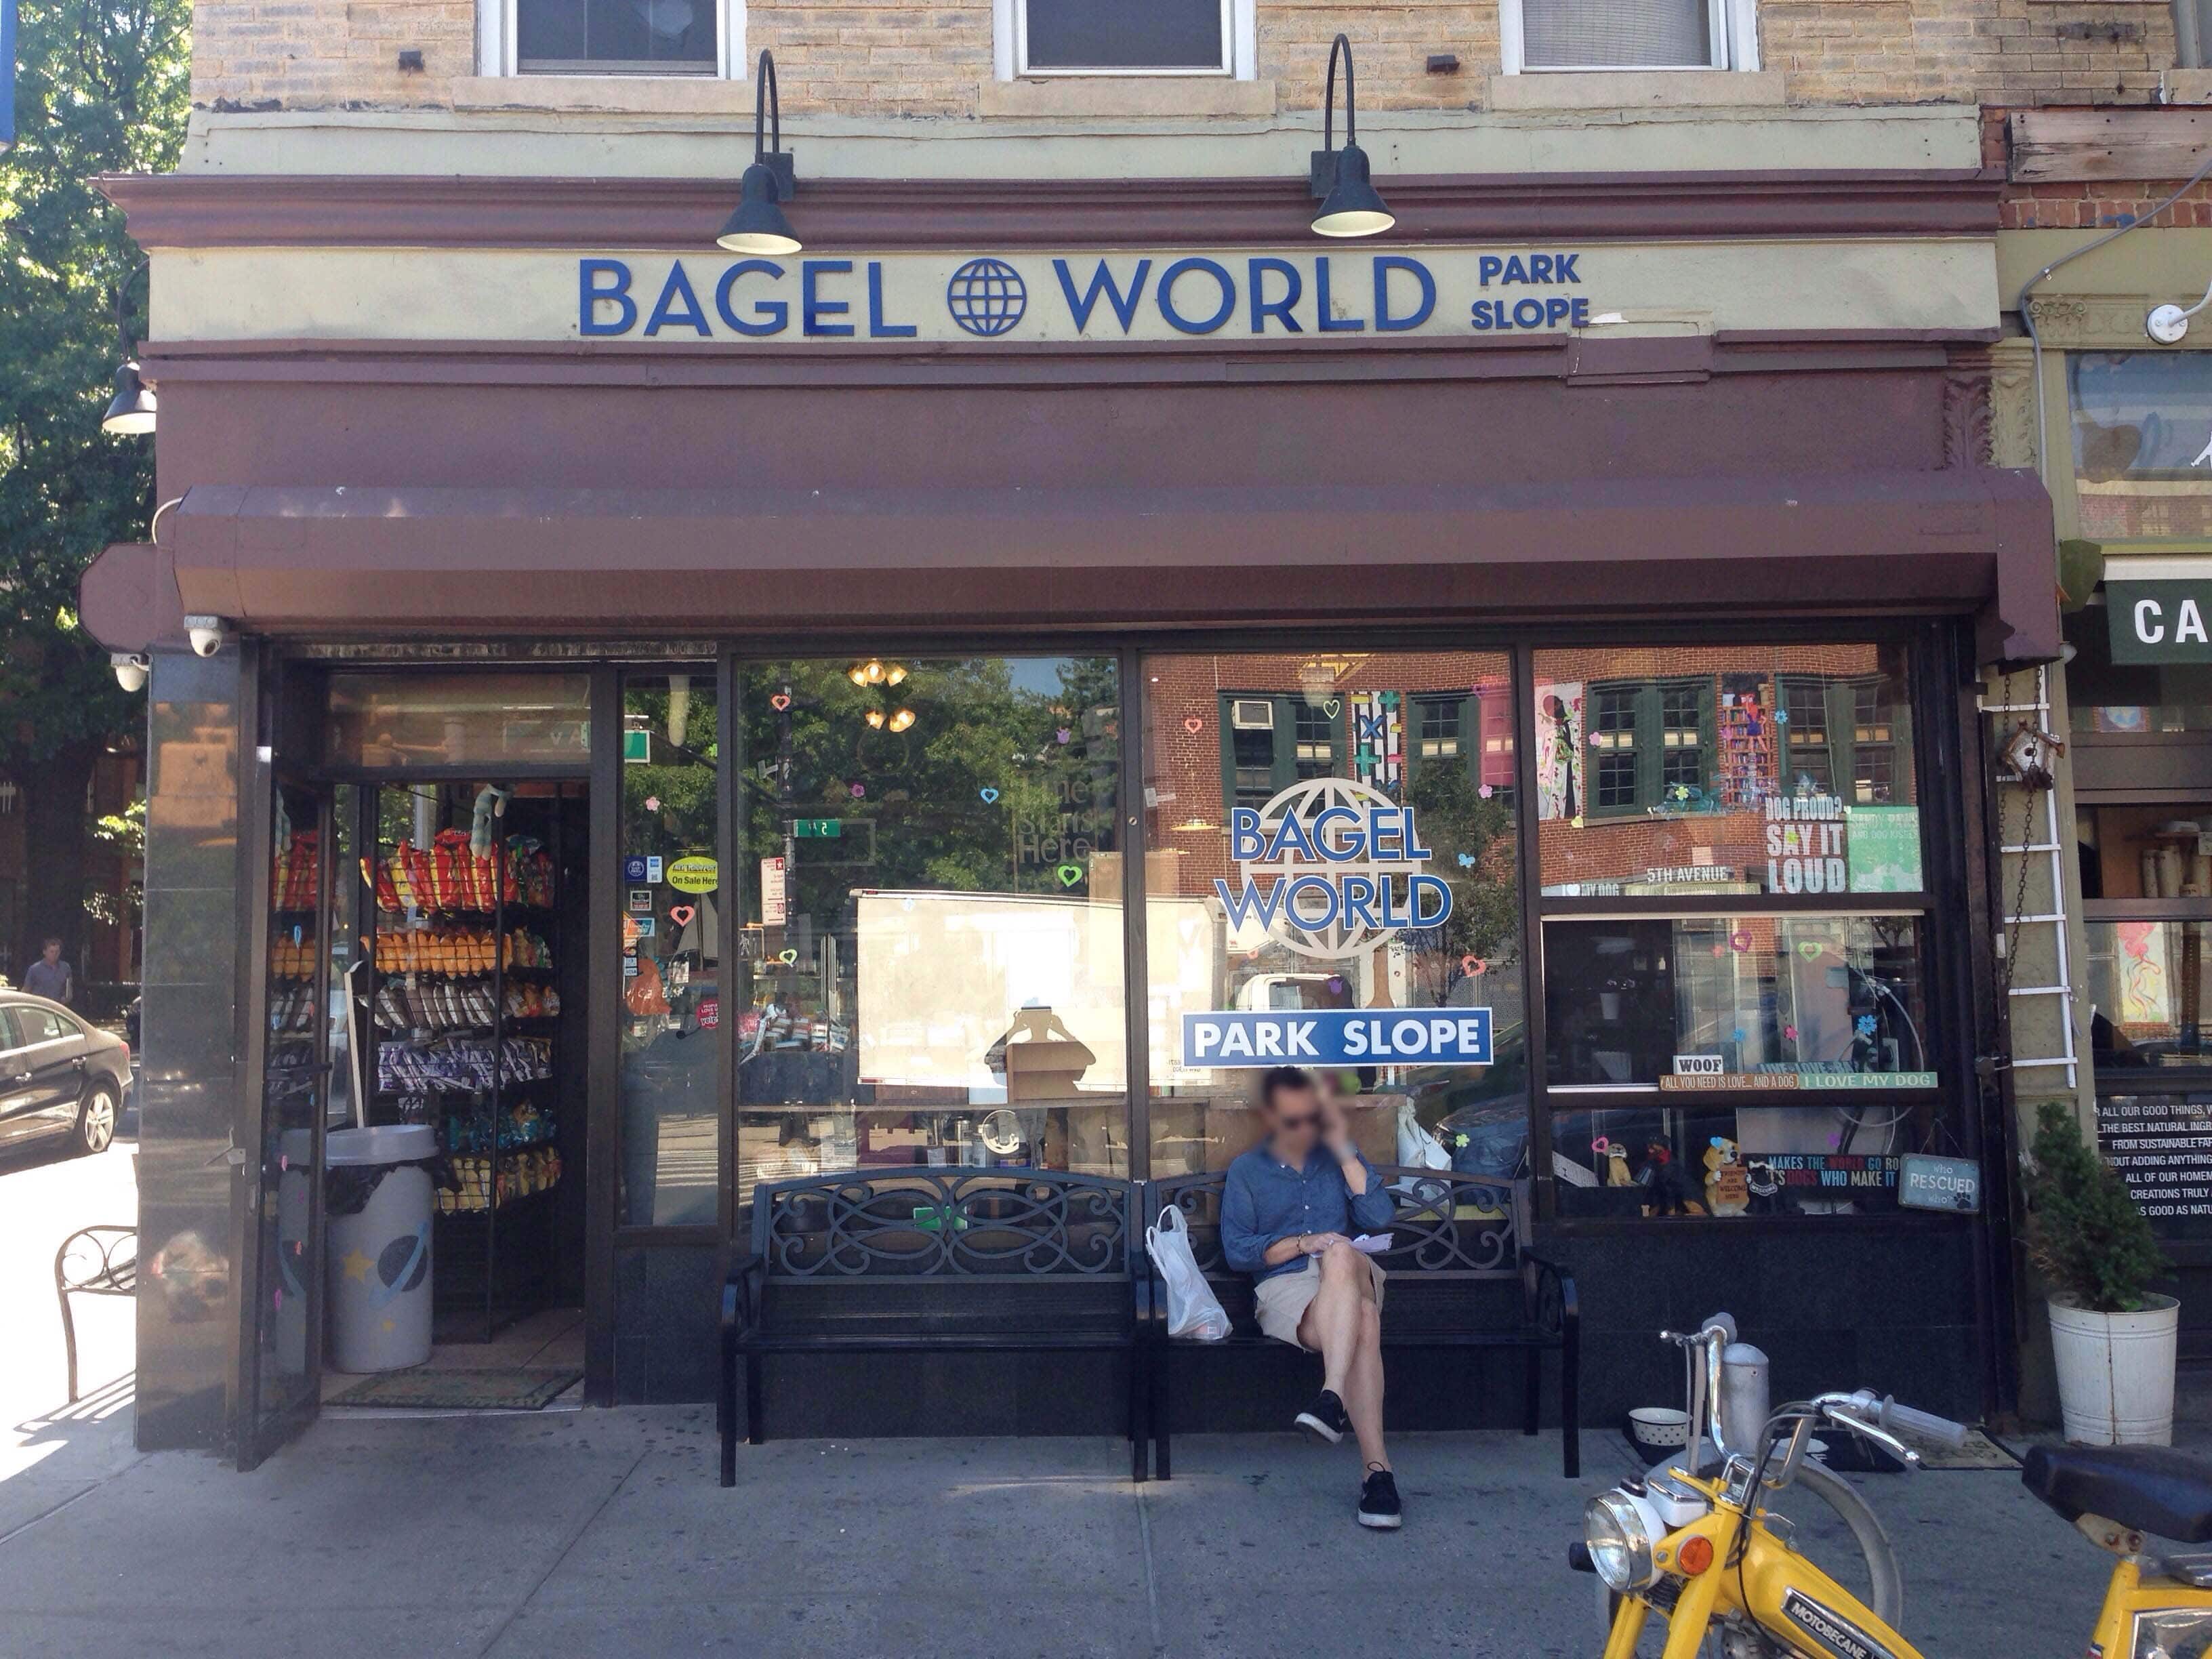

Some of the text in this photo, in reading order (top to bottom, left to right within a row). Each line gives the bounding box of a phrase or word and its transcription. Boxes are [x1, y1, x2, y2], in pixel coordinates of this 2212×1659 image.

[1479, 253, 1582, 287] PARK
[579, 256, 1437, 337] BAGEL WORLD
[1471, 298, 1589, 330] SLOPE
[2135, 599, 2209, 644] CA
[1765, 796, 1790, 821] DOG
[1793, 796, 1843, 821] PROUD?
[1231, 805, 1432, 863] BAGEL
[1766, 823, 1844, 857] SAY IT
[672, 876, 682, 884] On
[684, 876, 701, 884] Sale
[1647, 865, 1729, 882] 5TH AVENUE
[1767, 857, 1847, 894] LOUD
[1214, 874, 1453, 933] WORLD
[1193, 1019, 1480, 1058] PARK SLOPE
[1678, 1059, 1722, 1073] WOOF
[1666, 1075, 1678, 1088] ALL
[1680, 1075, 1696, 1088] YOU
[1697, 1075, 1716, 1088] NEED
[1718, 1075, 1725, 1088] IS
[1754, 1075, 1768, 1088] AND
[1771, 1075, 1777, 1088] A
[1778, 1075, 1794, 1088] DOG
[1805, 1074, 1931, 1088] I LOVE MY DOG
[2103, 1107, 2119, 1117] ALL
[2121, 1106, 2140, 1116] OUR
[2142, 1105, 2168, 1115] GOOD
[2169, 1104, 2205, 1115] THINGS,
[2101, 1123, 2120, 1133] THE
[2122, 1122, 2145, 1132] BEST
[2147, 1122, 2189, 1132] NATURAL
[2112, 1140, 2137, 1150] FROM
[2139, 1138, 2196, 1149] SUSTAINABLE
[1768, 1156, 1803, 1170] MAKES
[1807, 1156, 1825, 1170] THE
[1868, 1157, 1882, 1170] GO
[2131, 1155, 2166, 1166] ADDING
[1820, 1170, 1847, 1187] WHO
[1851, 1170, 1882, 1187] MAKE
[1885, 1171, 1897, 1187] IT
[1910, 1172, 1975, 1193] RESCUED
[2125, 1173, 2142, 1183] ALL
[2144, 1172, 2156, 1183] OF
[2158, 1172, 2178, 1182] OUR
[2130, 1189, 2180, 1200] CREATIONS
[2182, 1187, 2209, 1198] TRULY
[2148, 1206, 2174, 1216] GOOD
[2175, 1205, 2189, 1215] AS
[1791, 1601, 1867, 1659] MOTOBECANE
